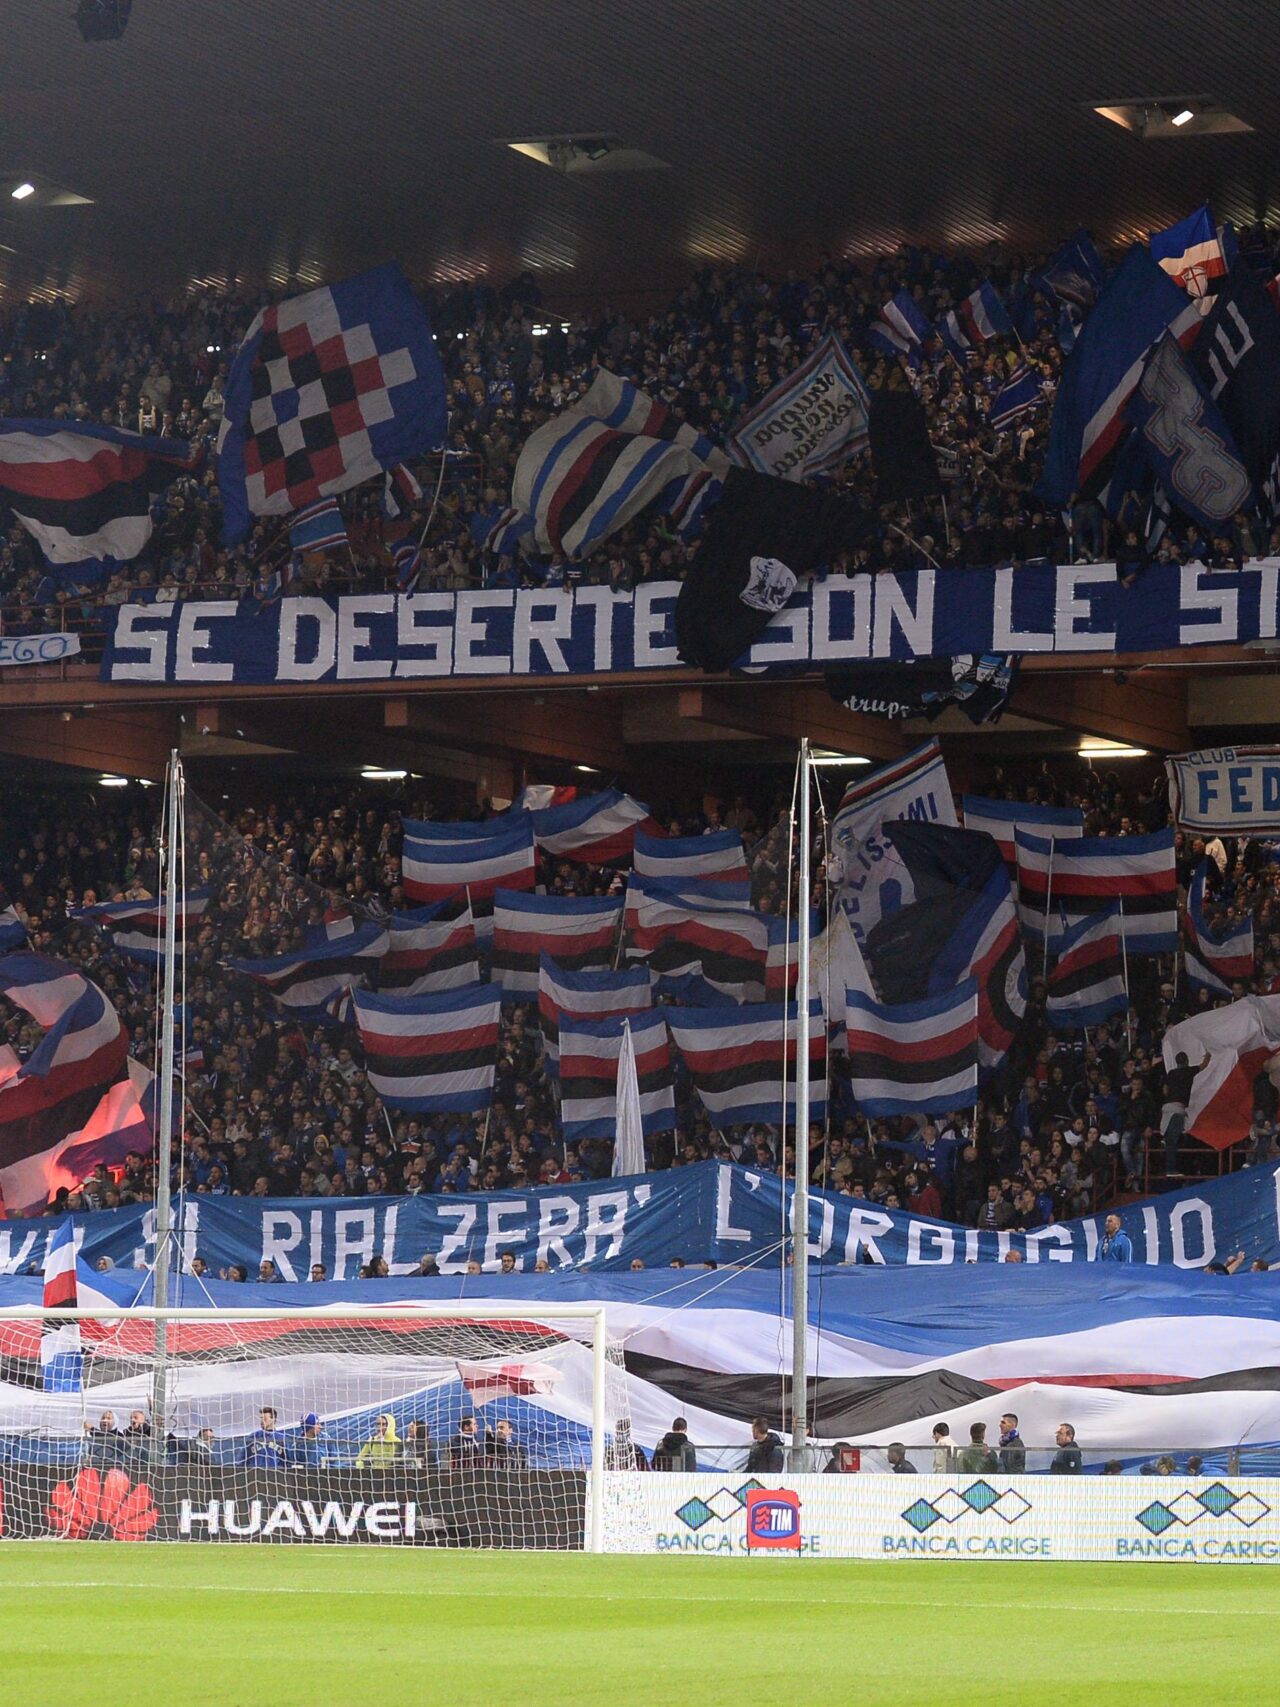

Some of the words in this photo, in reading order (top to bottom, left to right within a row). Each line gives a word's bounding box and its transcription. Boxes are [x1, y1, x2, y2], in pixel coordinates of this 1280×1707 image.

[111, 600, 238, 681] SE
[276, 580, 684, 680] DESERTE
[993, 562, 1117, 651] LE
[1189, 749, 1236, 765] CLUB
[180, 1499, 417, 1538] HUAWEI
[770, 1508, 793, 1532] TIM
[656, 1532, 733, 1552] BANCA
[882, 1535, 961, 1554] BANCA
[967, 1536, 1052, 1556] CARIGE
[1116, 1537, 1197, 1557] BANCA
